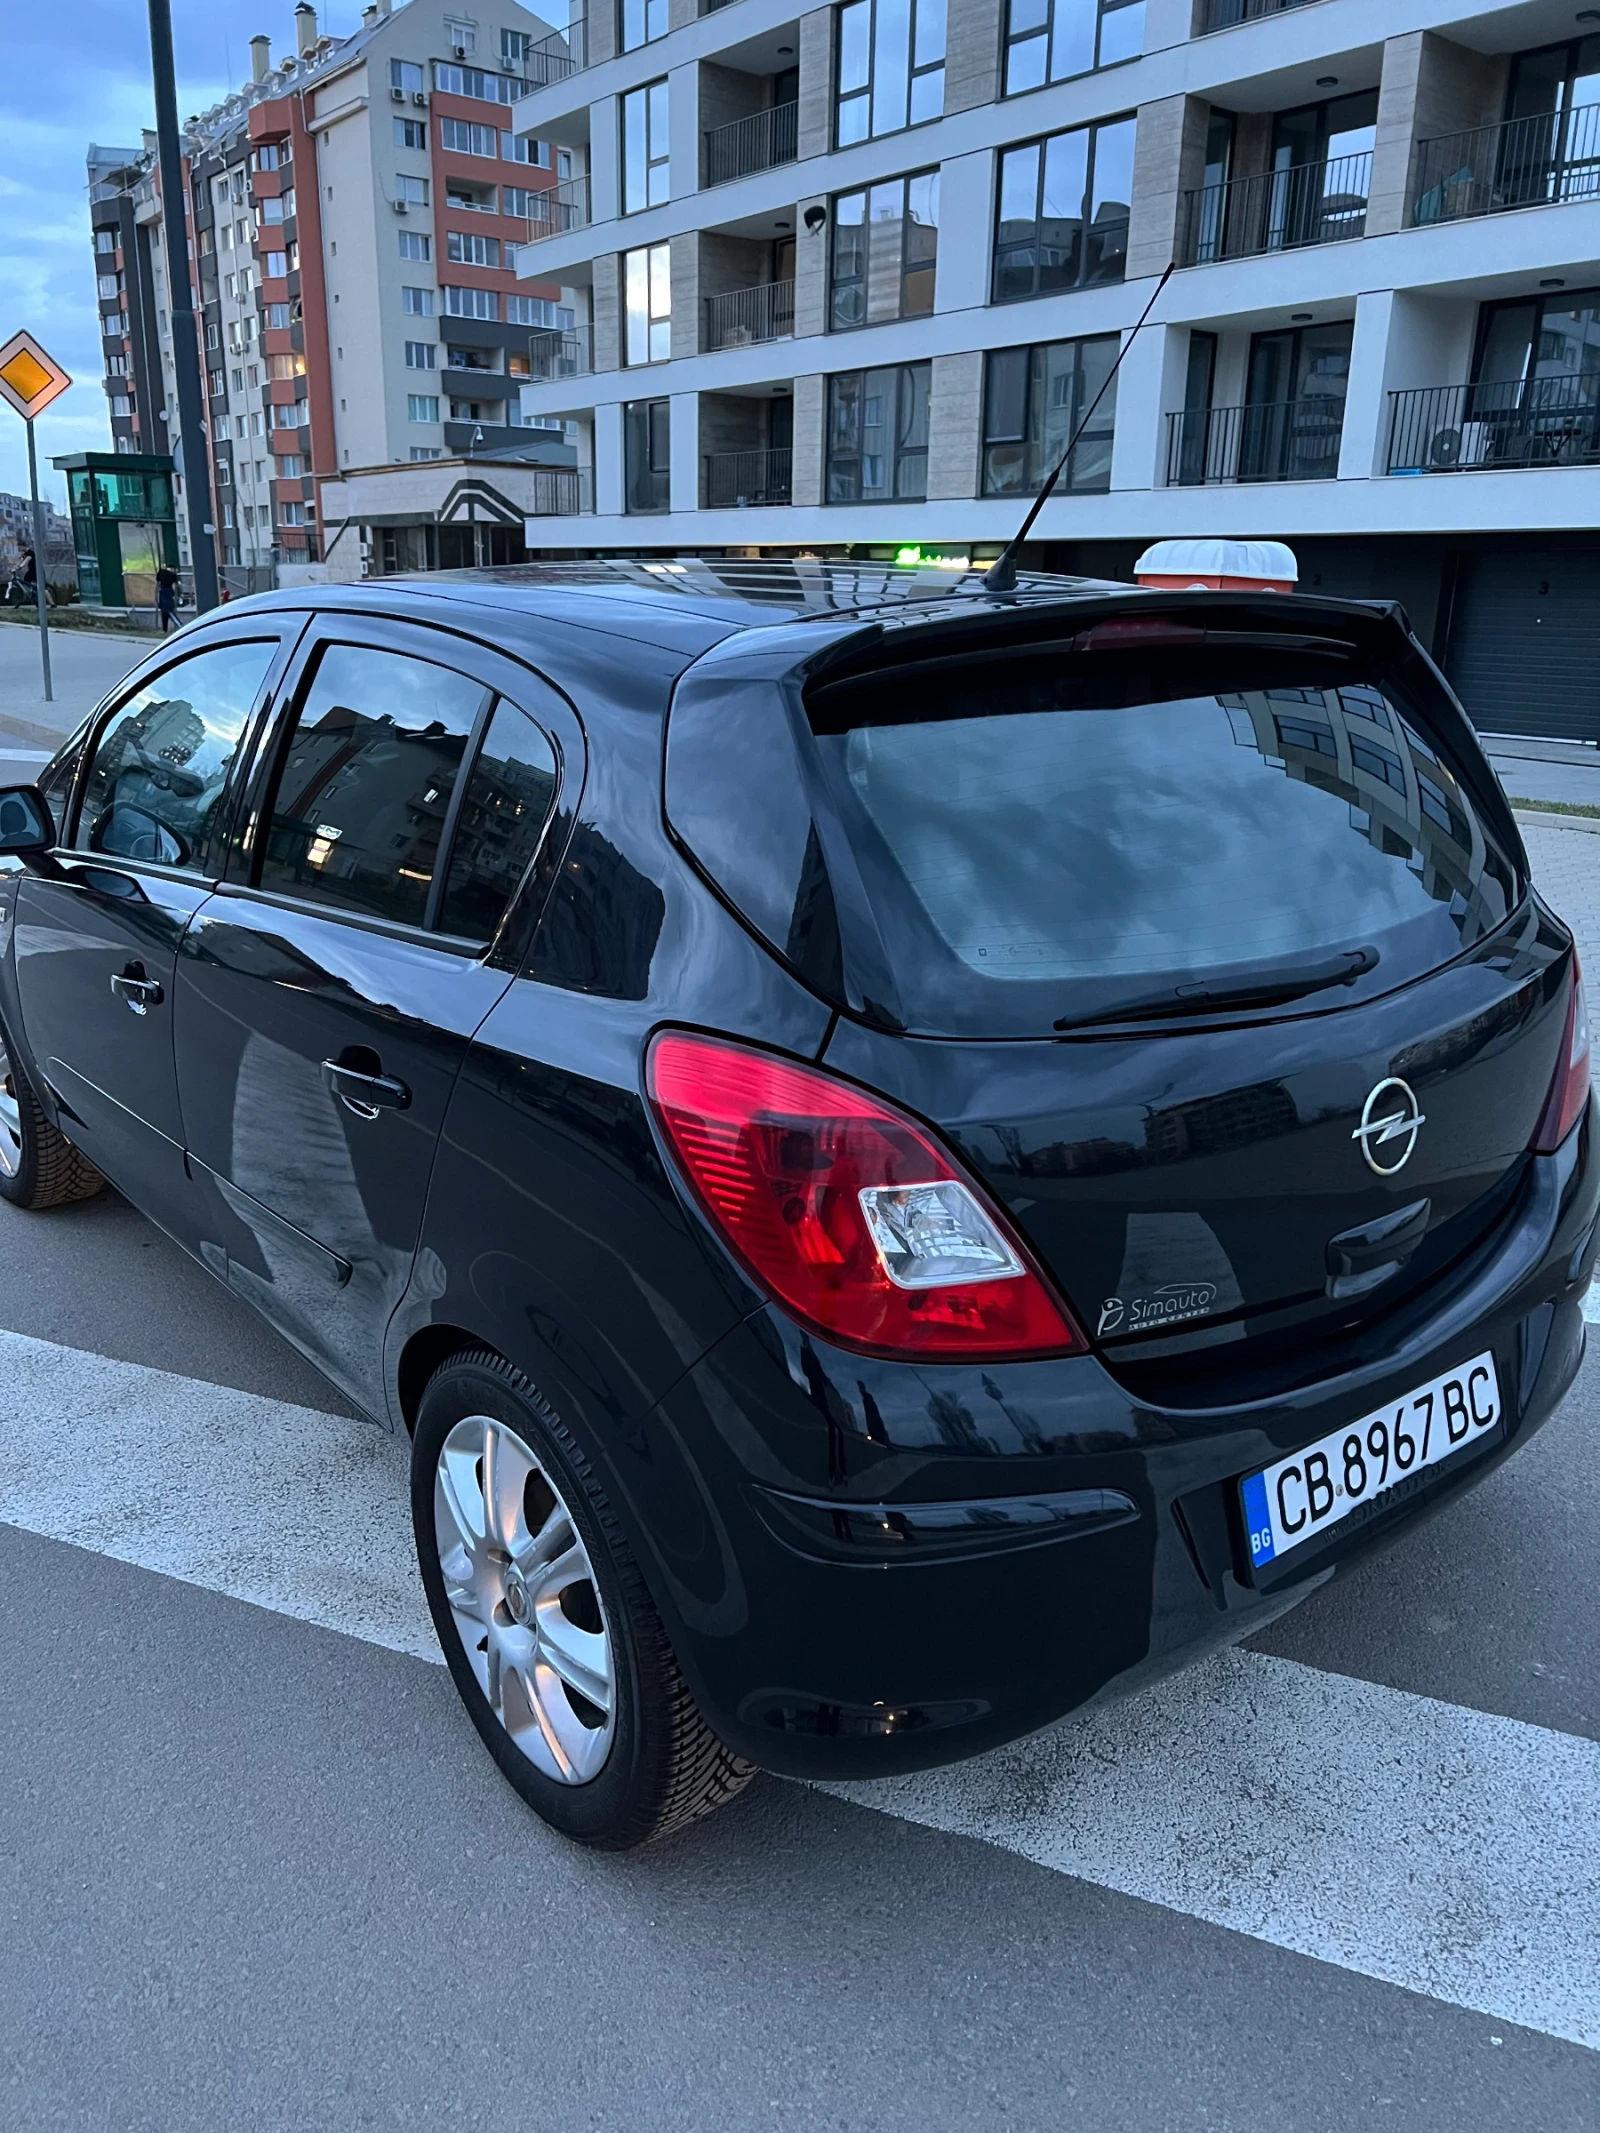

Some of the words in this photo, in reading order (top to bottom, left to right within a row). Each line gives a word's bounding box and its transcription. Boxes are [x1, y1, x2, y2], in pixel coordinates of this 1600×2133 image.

[1313, 573, 1322, 585] 2
[1537, 581, 1549, 595] 3
[1130, 1290, 1210, 1321] Simauto
[1277, 1451, 1334, 1535] CB
[1342, 1392, 1433, 1498] 8967
[1443, 1366, 1494, 1445] BC
[1251, 1528, 1271, 1554] BG
